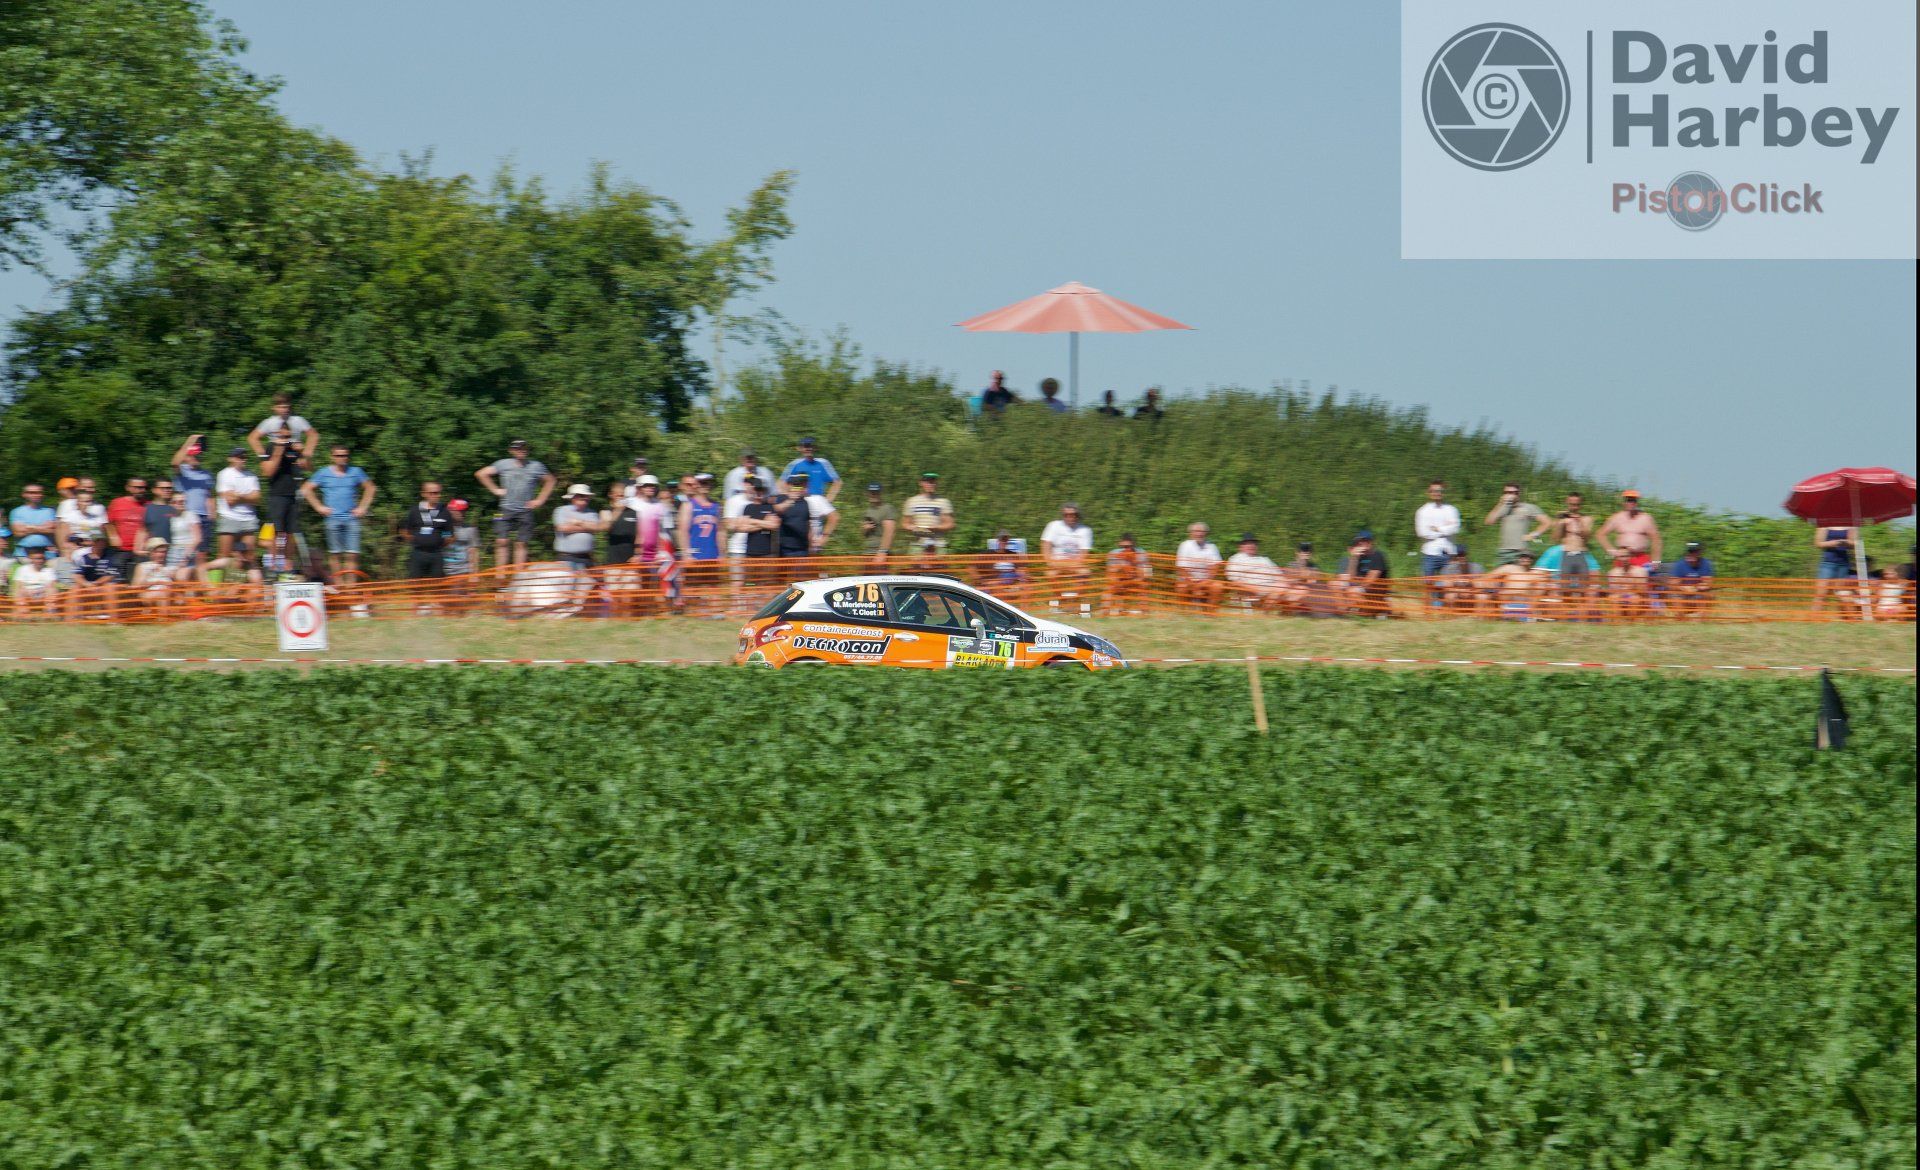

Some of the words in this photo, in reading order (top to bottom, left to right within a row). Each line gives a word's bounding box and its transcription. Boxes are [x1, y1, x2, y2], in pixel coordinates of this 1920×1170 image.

[856, 583, 879, 602] 76
[803, 624, 883, 637] containerdienst
[998, 641, 1012, 657] 76
